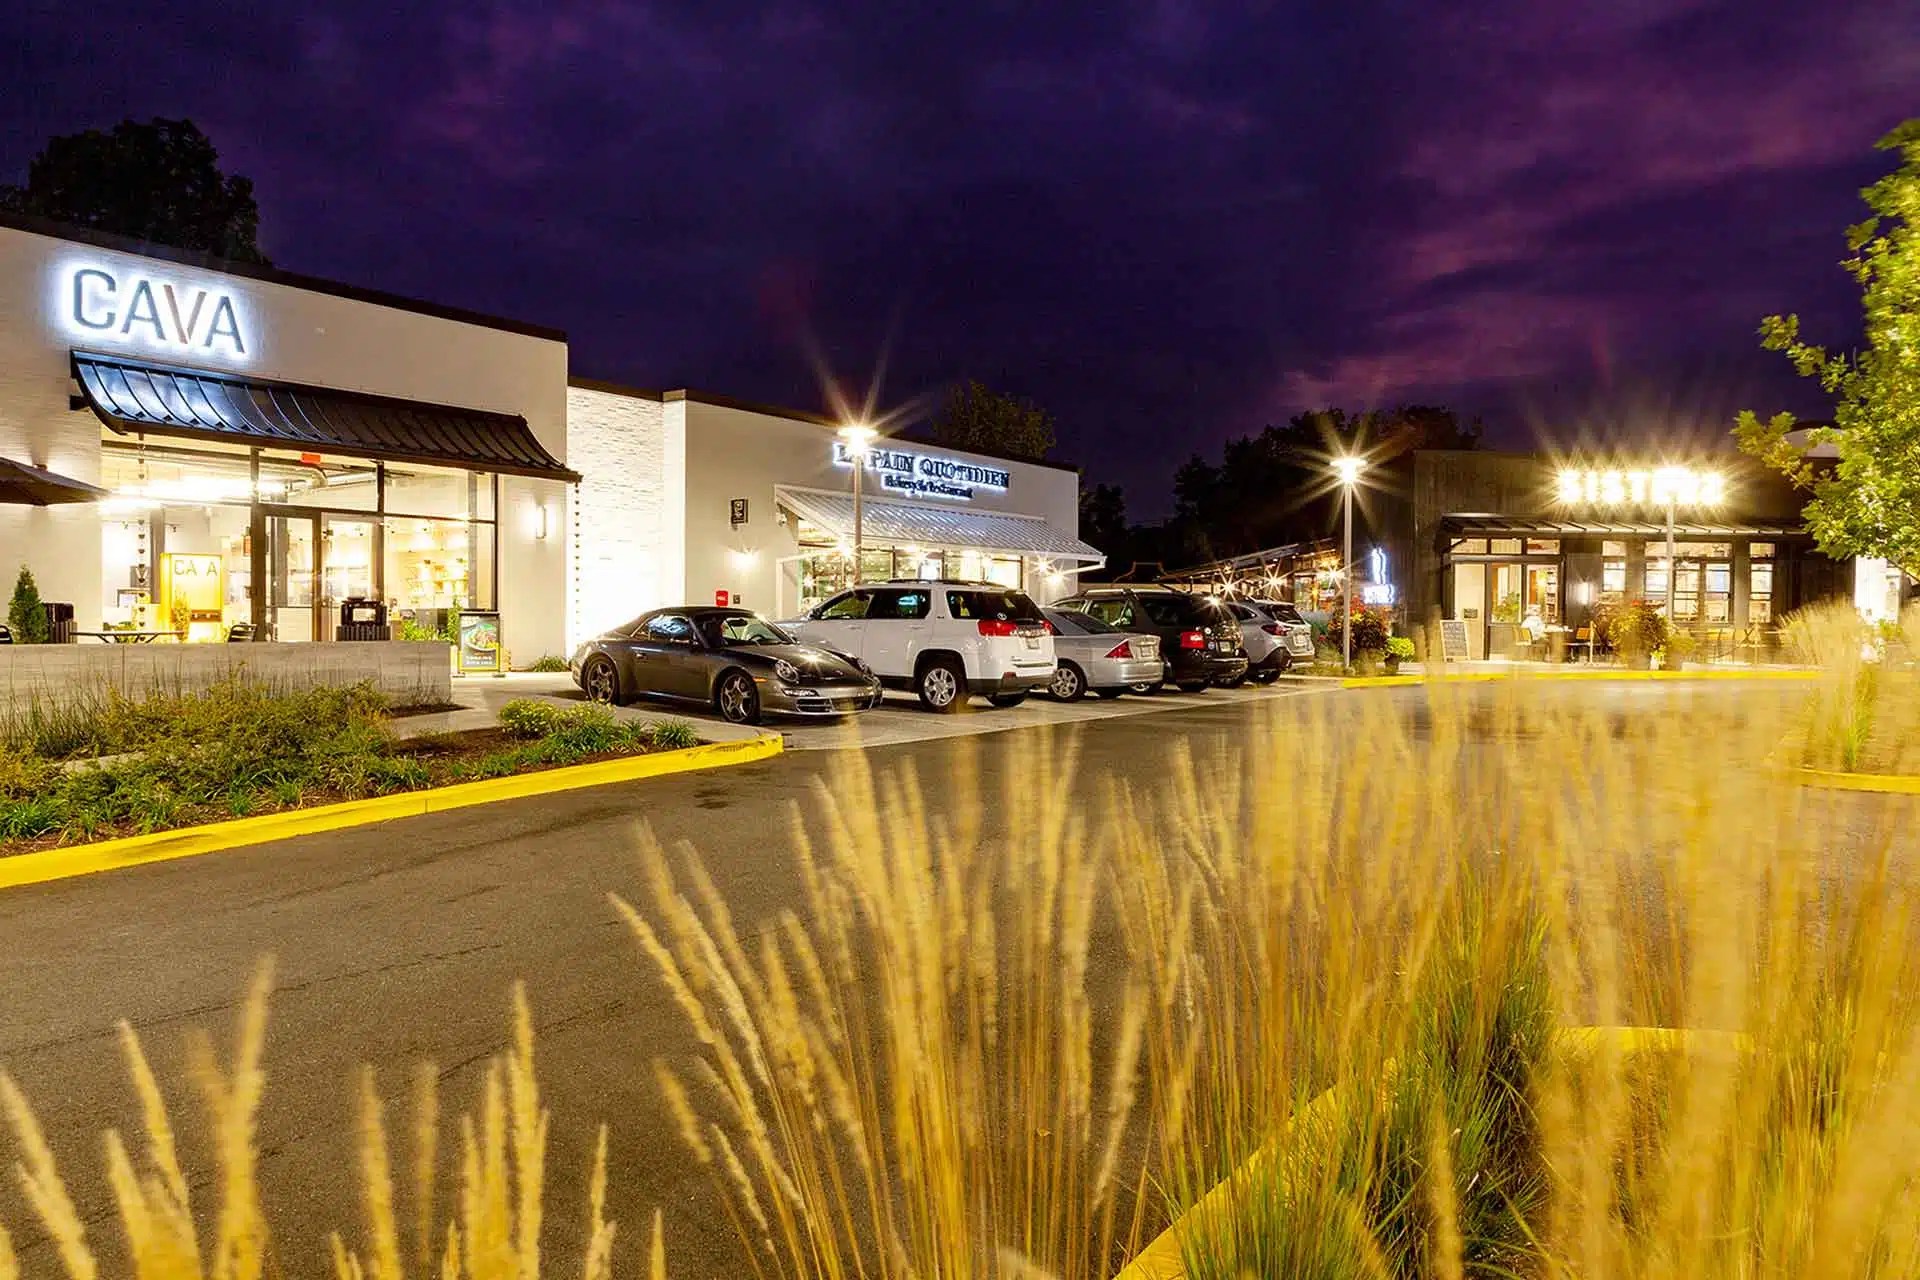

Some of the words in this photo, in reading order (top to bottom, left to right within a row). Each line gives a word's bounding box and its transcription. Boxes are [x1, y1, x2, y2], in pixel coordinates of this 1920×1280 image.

[73, 269, 246, 354] CAVA
[870, 450, 914, 474] PAIN
[919, 457, 1011, 488] QUOTIDIEN
[1557, 468, 1725, 506] SISTS
[174, 559, 218, 577] CAA
